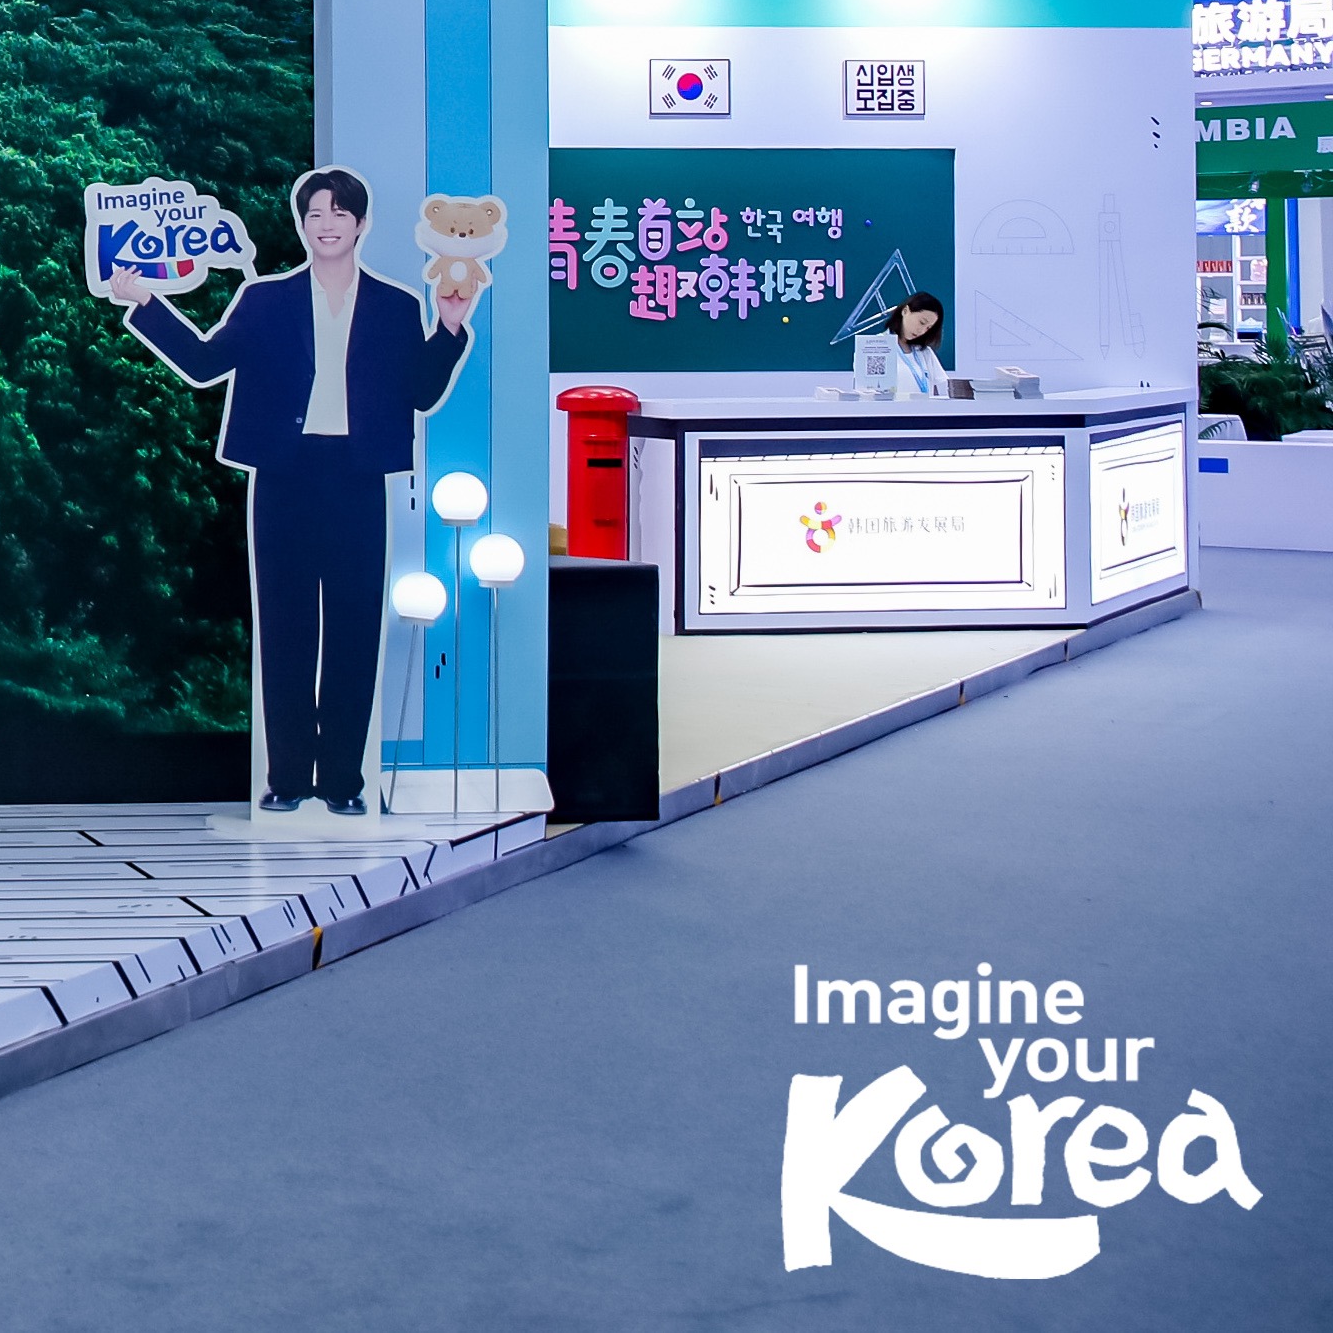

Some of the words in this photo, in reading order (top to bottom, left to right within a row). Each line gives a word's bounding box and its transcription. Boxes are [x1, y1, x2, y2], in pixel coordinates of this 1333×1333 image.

[856, 64, 915, 87] 신입생
[856, 88, 915, 112] 모집중
[96, 187, 185, 211] Imagine
[154, 203, 207, 227] your
[97, 218, 244, 282] Korea
[549, 197, 730, 291] 青春首站
[739, 206, 784, 244] 한국
[792, 206, 844, 240] 여행
[629, 253, 844, 322] 趣韩报到
